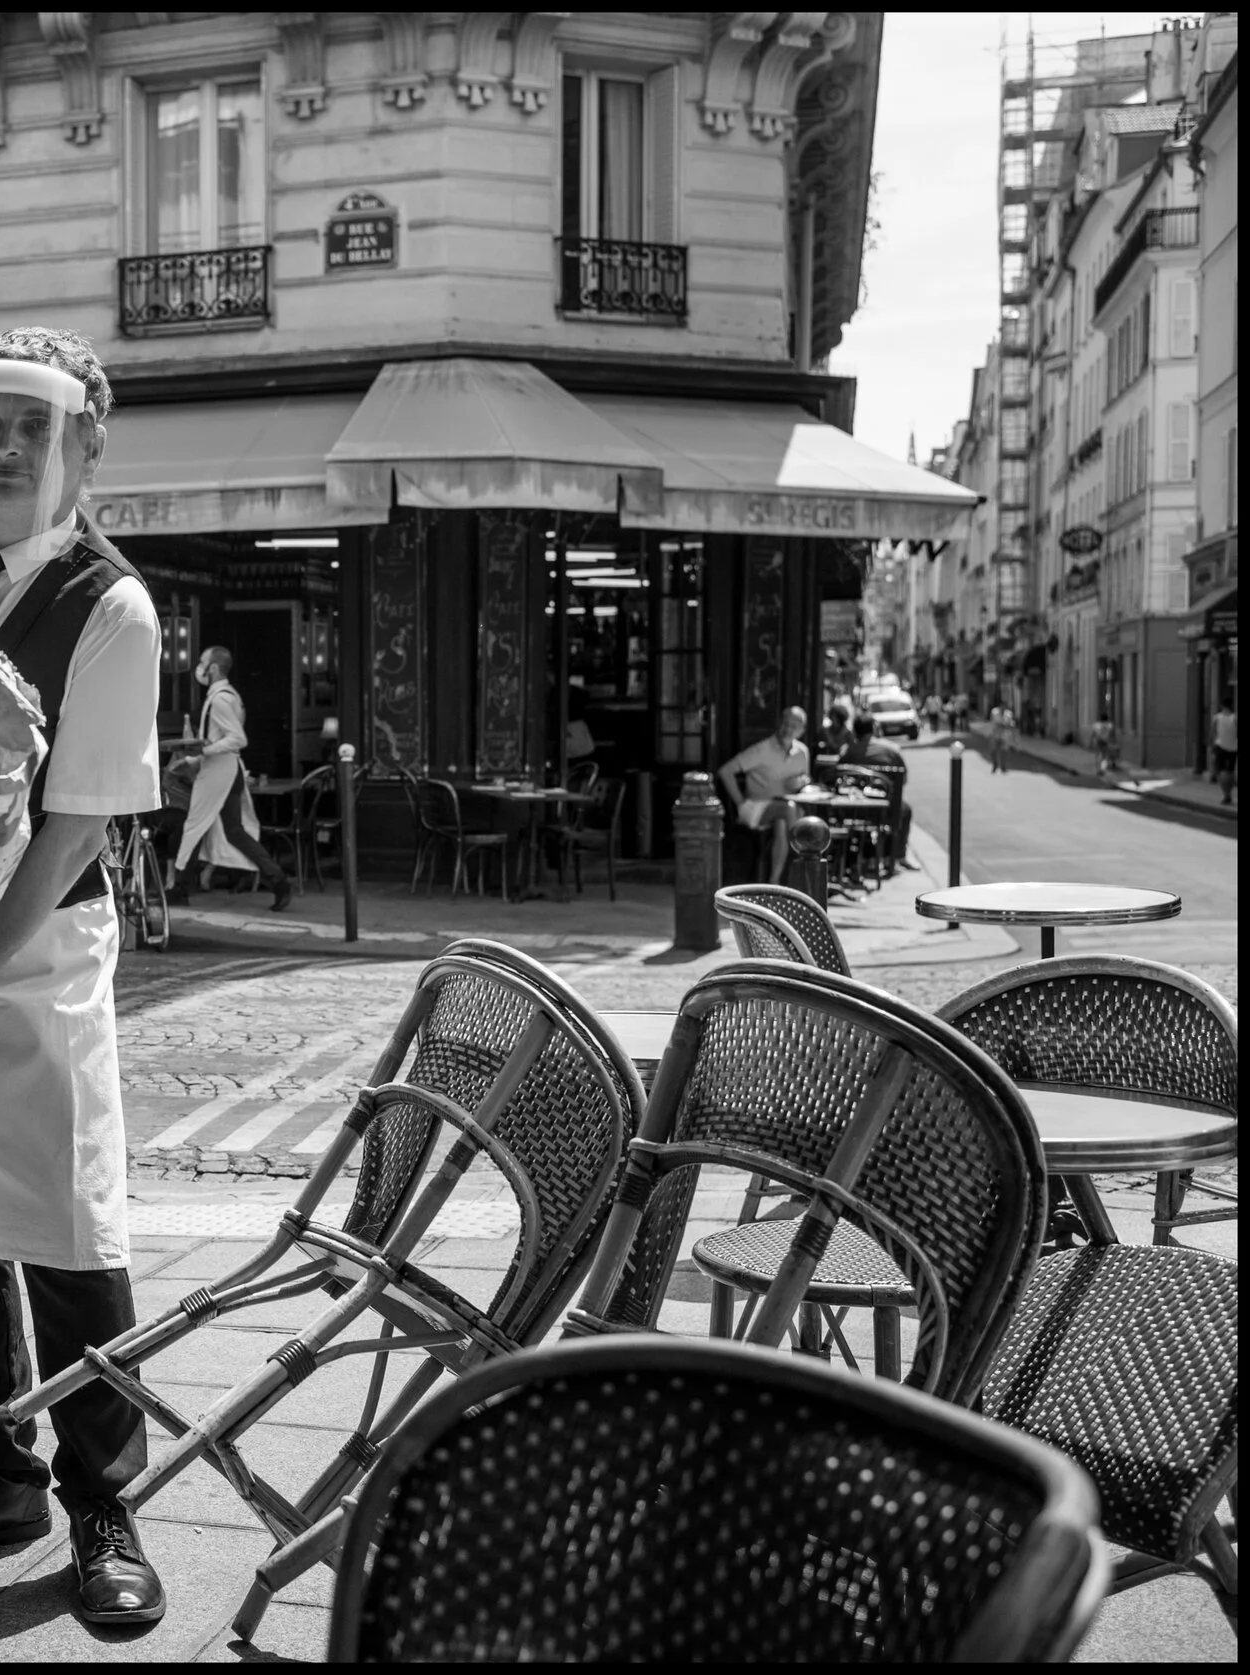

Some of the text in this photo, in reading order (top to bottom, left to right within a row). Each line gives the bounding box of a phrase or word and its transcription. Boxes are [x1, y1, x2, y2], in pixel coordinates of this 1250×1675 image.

[349, 222, 375, 235] RUE
[346, 235, 379, 249] JEAN
[330, 251, 345, 264] DU
